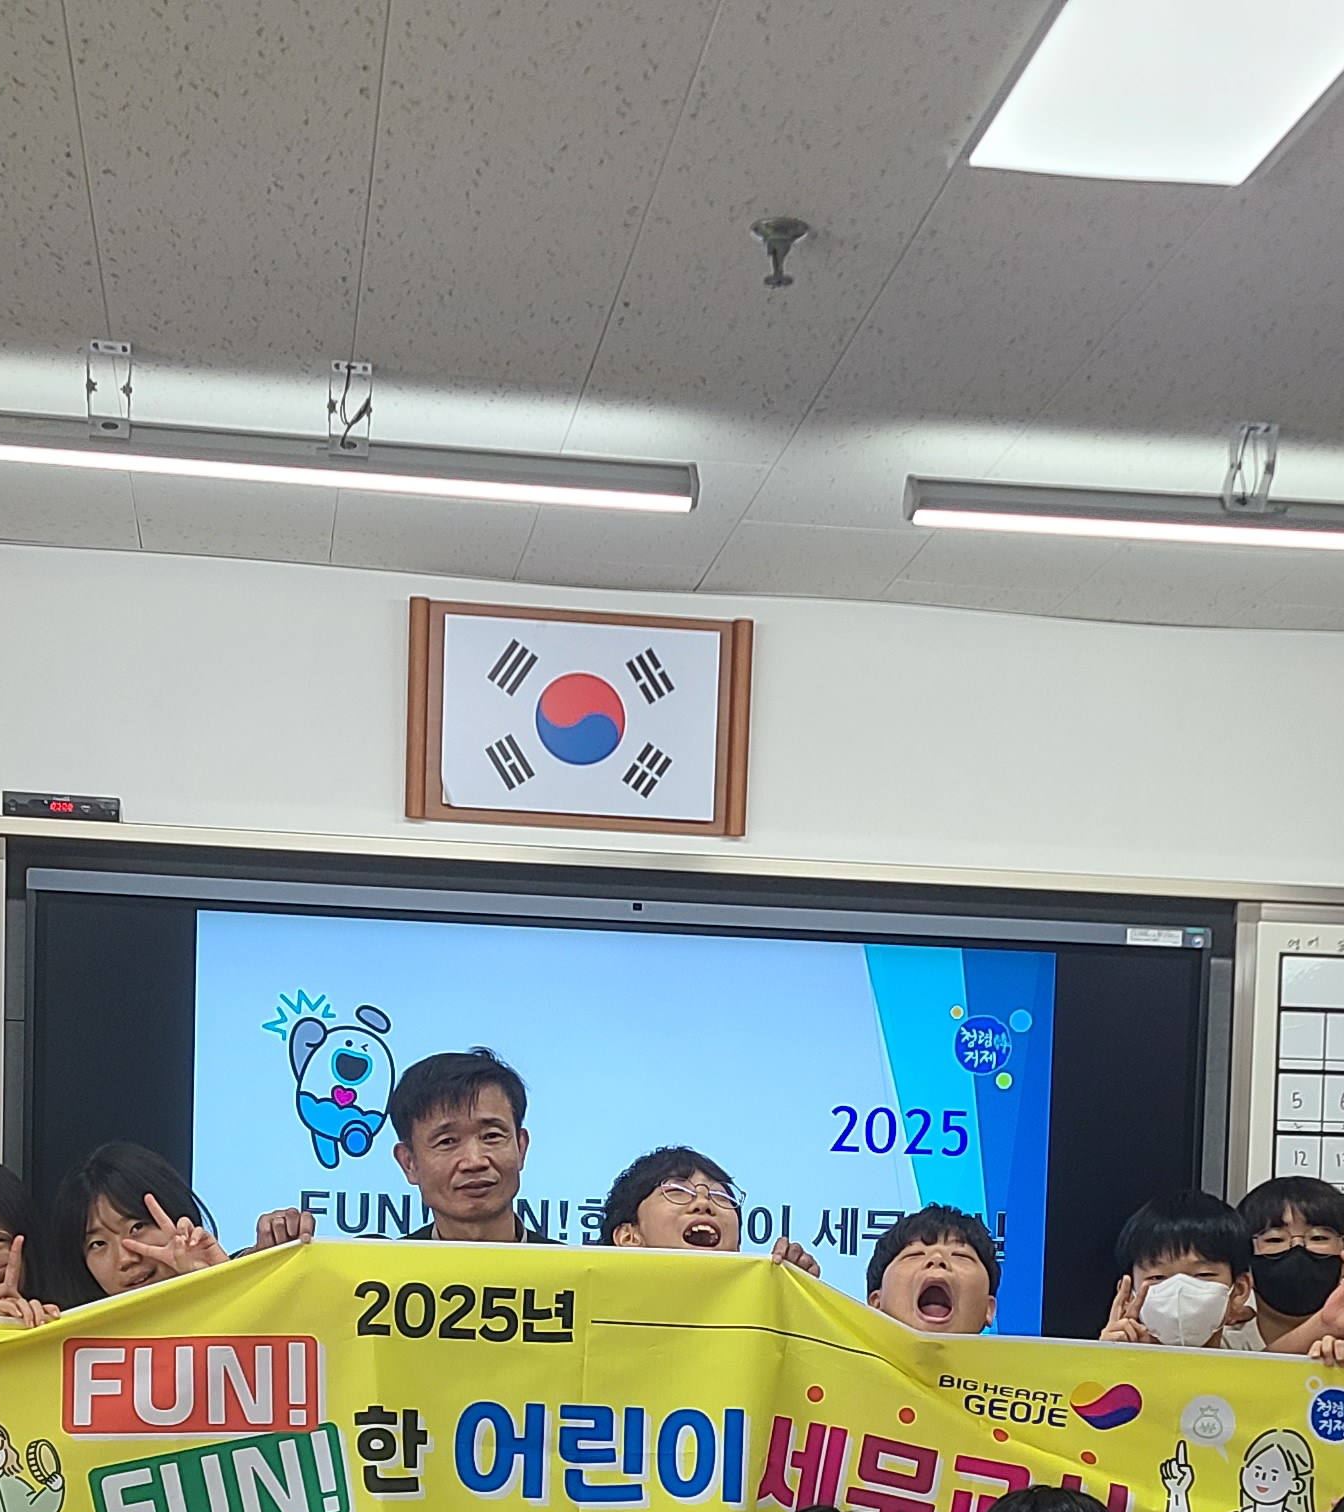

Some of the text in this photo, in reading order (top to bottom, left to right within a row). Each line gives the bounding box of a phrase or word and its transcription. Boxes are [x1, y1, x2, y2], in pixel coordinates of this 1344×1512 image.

[964, 1049, 996, 1070] 거제
[1292, 1091, 1303, 1109] 5
[828, 1103, 970, 1158] 2025
[1294, 1150, 1308, 1167] 12
[353, 1280, 575, 1344] 2025년
[71, 1344, 311, 1427] FUN!
[939, 1374, 1064, 1405] BIG HEART
[964, 1393, 1069, 1428] GEOJE
[353, 1405, 429, 1495] 한
[454, 1400, 747, 1505] 어린이
